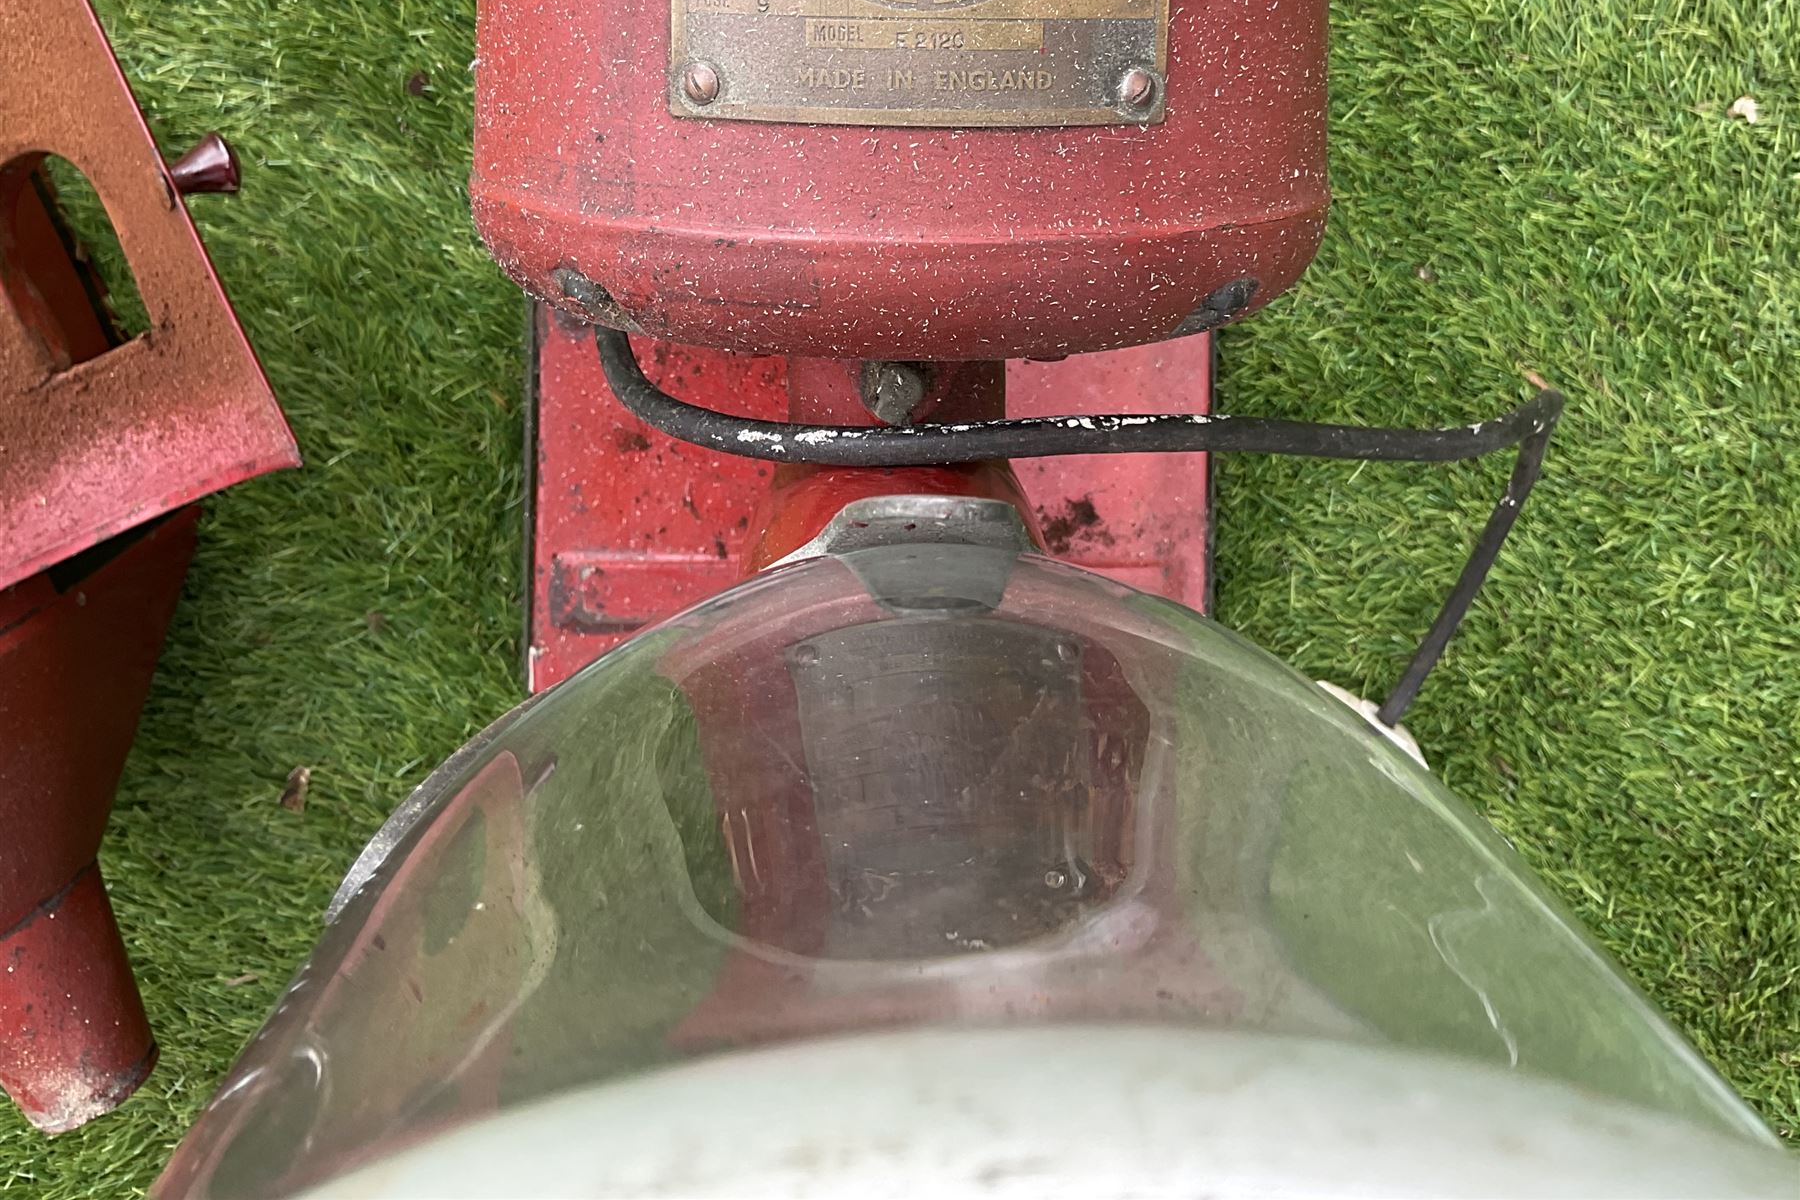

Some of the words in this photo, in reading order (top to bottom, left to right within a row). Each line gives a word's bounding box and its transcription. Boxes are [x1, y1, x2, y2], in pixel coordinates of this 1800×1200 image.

[813, 24, 865, 43] MODEL
[798, 67, 866, 90] MADE
[886, 68, 914, 90] IN
[935, 69, 1054, 92] ENGLAND
